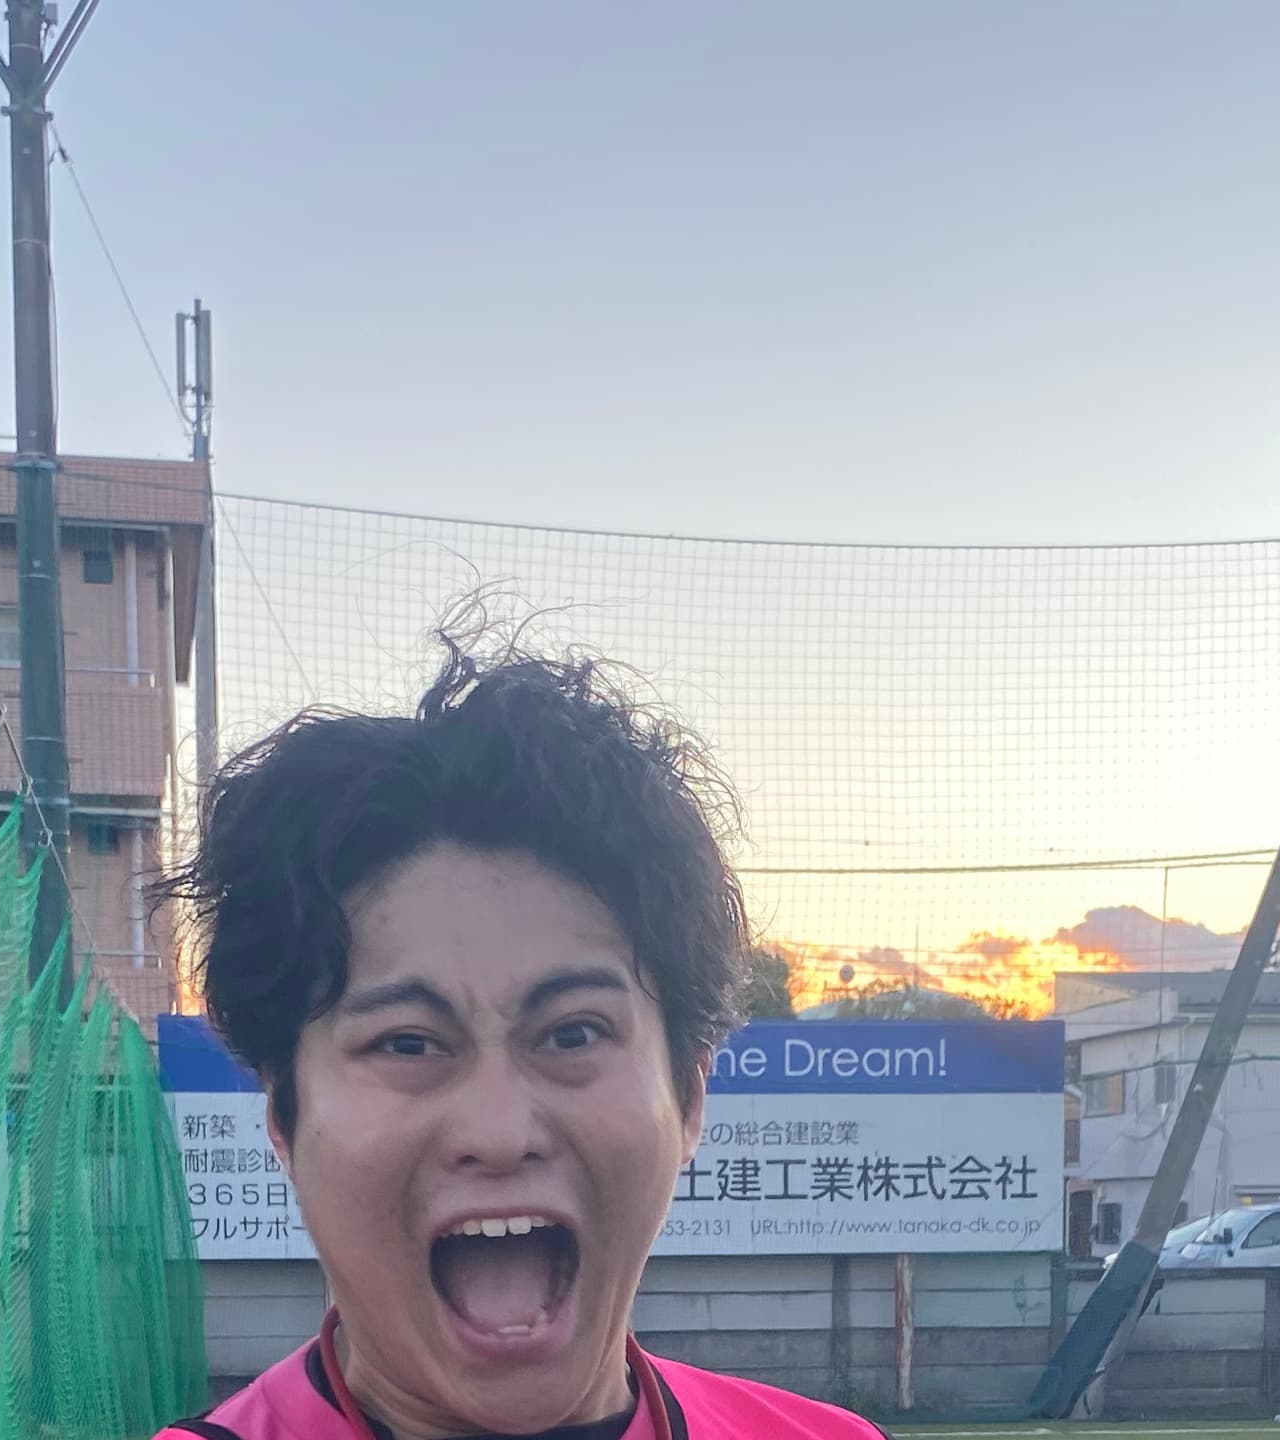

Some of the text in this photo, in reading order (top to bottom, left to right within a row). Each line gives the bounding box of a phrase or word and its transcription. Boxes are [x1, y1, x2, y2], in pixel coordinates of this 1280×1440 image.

[784, 1039, 946, 1077] Dream!
[673, 1154, 1038, 1202] 土建工業株式会社
[659, 1219, 730, 1236] 53-2131
